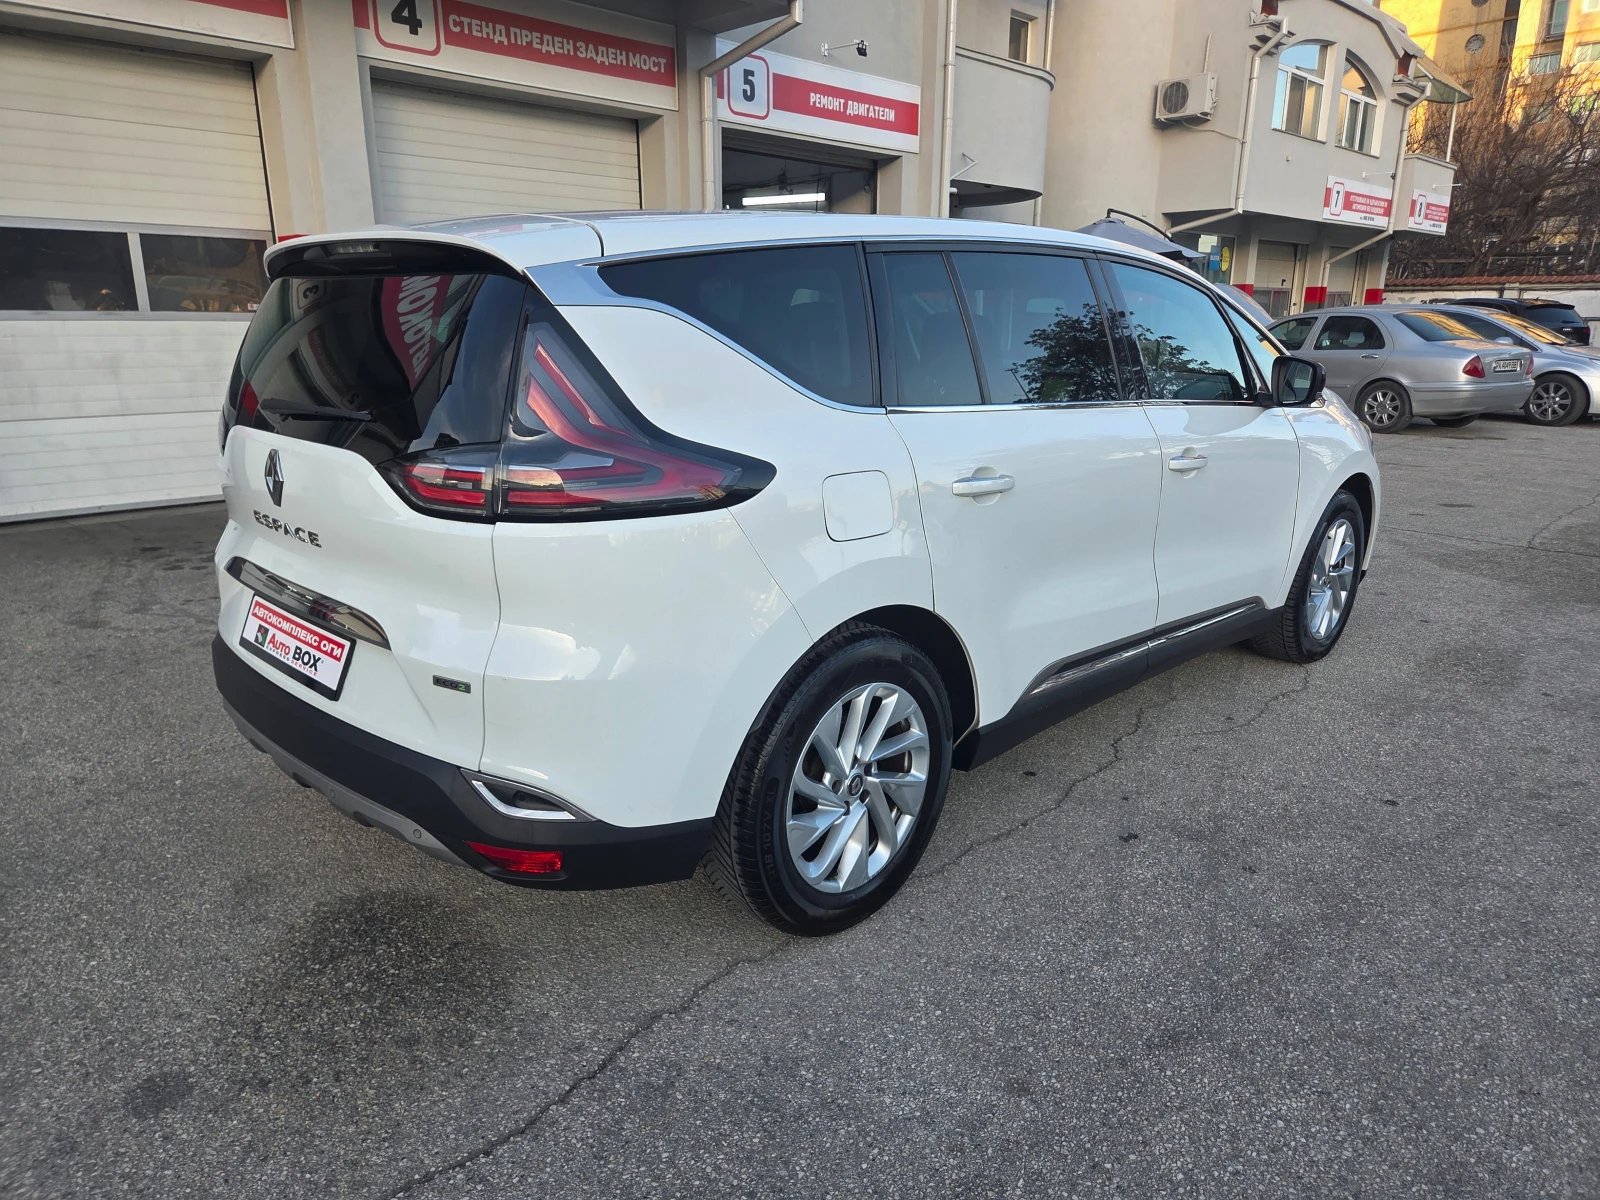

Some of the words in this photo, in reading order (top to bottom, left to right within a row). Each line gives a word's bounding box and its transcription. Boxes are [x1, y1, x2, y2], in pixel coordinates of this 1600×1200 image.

[391, 0, 422, 35] 4
[448, 14, 508, 45] СТЕНД
[509, 26, 574, 56] ПРЕДЕН
[576, 41, 626, 66] ЗАДЕН
[629, 52, 666, 73] МОСТ
[742, 68, 756, 102] 5
[809, 92, 846, 113] РЕМОНТ
[846, 100, 895, 122] ДВИГАТЕЛИ
[1334, 190, 1341, 208] 7
[253, 509, 322, 548] ESPACE
[253, 605, 320, 647] АВТОКОМПЛЕКС
[320, 640, 342, 658] ОГИ
[291, 660, 318, 677] SERVICE
[292, 645, 321, 672] BOX
